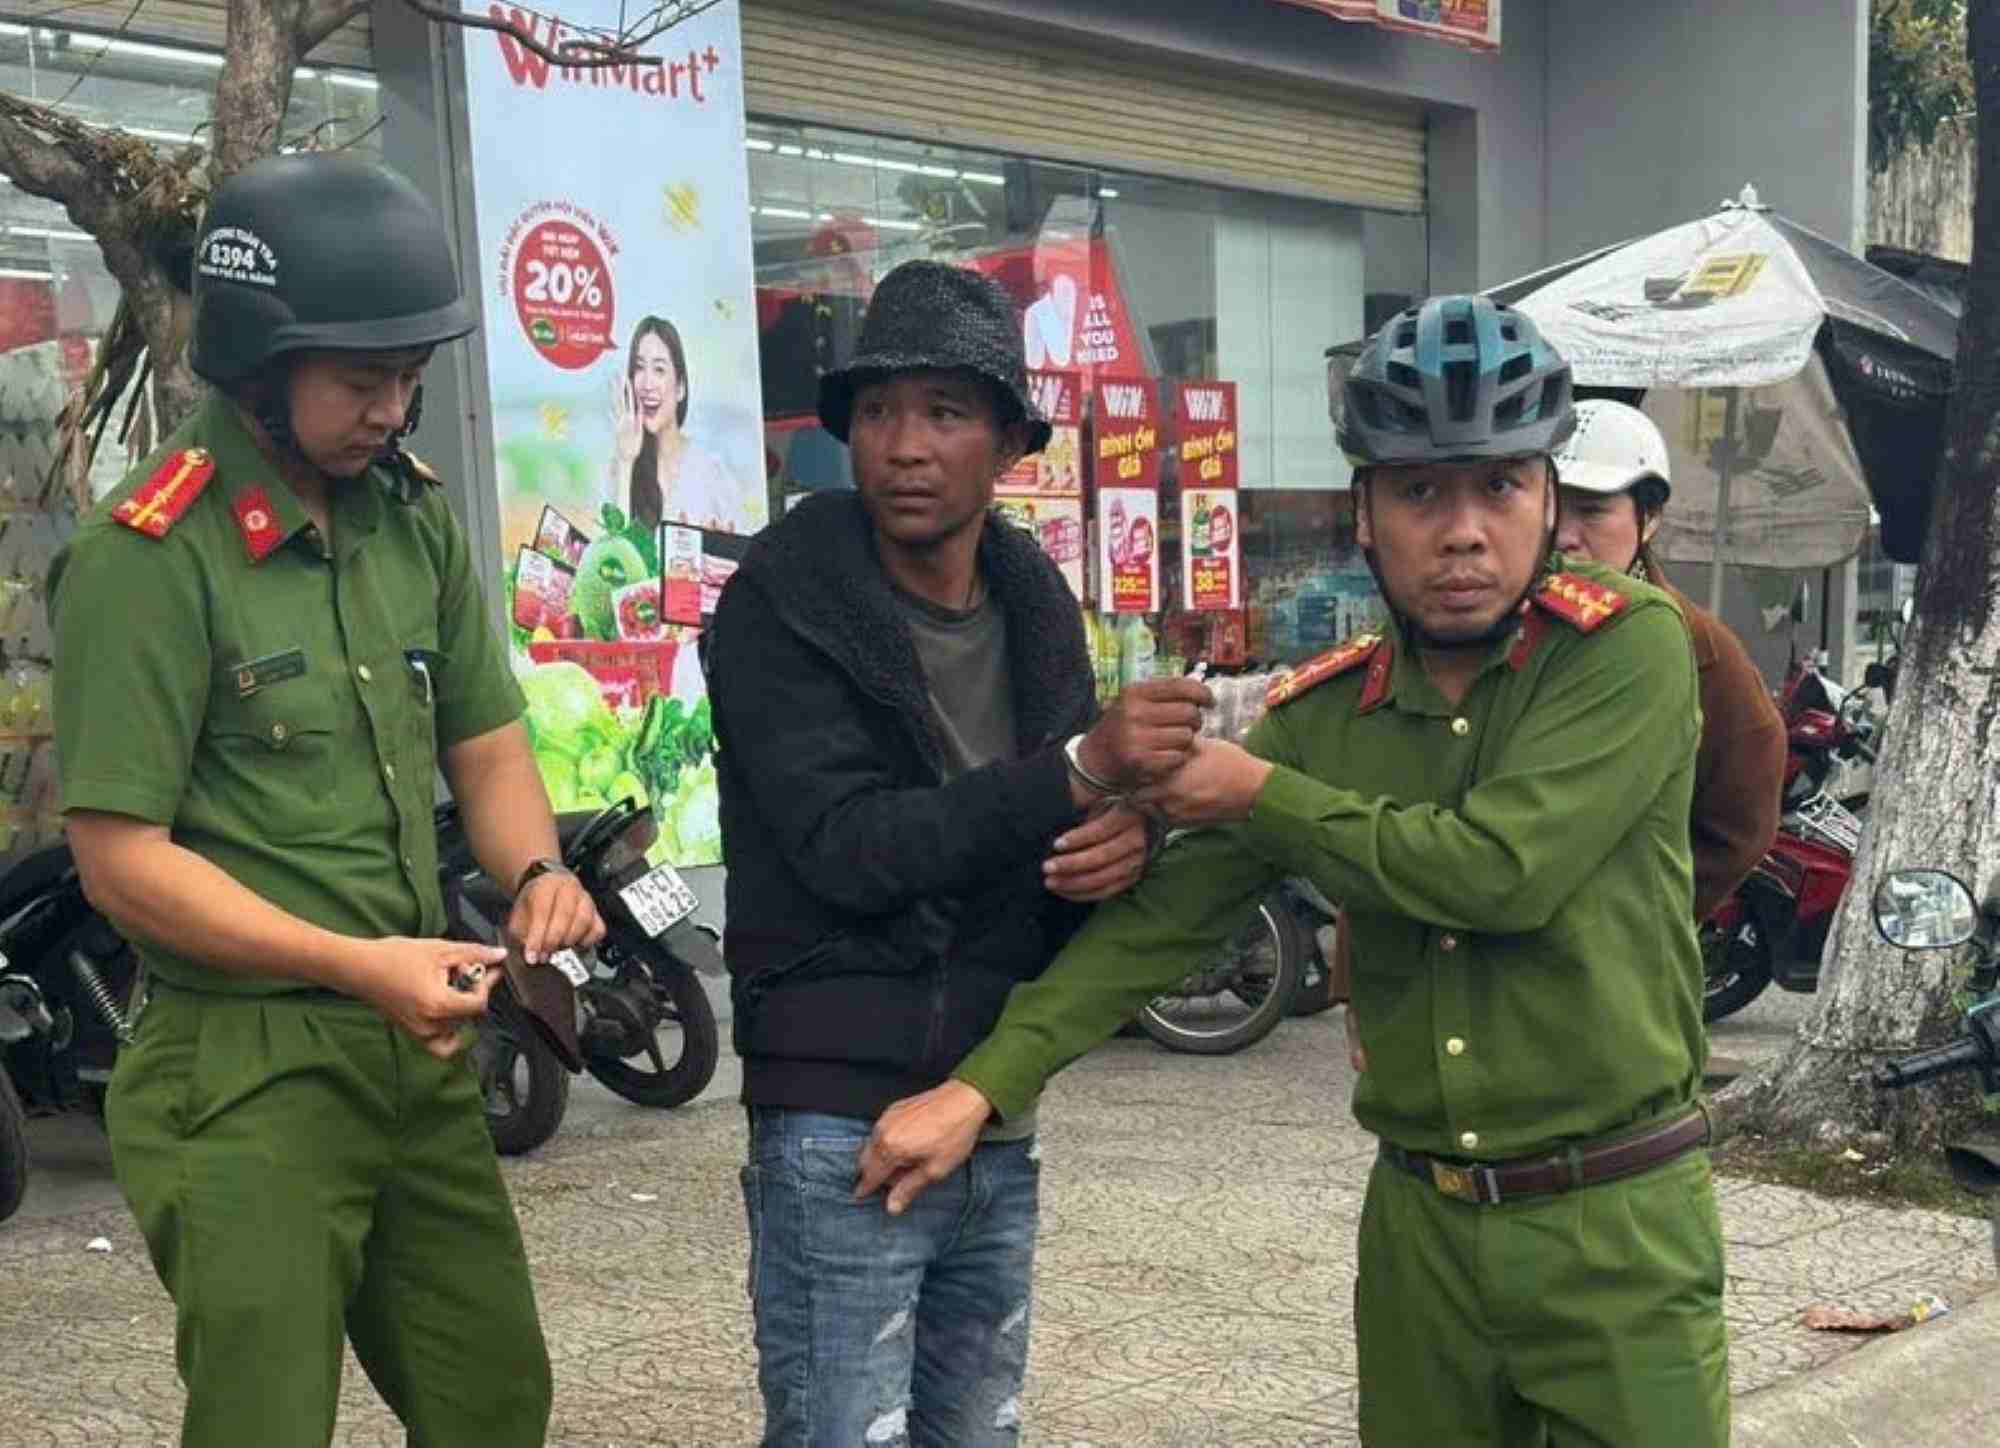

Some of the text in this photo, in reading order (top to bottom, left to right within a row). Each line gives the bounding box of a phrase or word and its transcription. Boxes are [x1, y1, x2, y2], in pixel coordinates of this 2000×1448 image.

[210, 243, 256, 271] 8394
[524, 259, 603, 308] 20%
[1078, 330, 1115, 347] YOU
